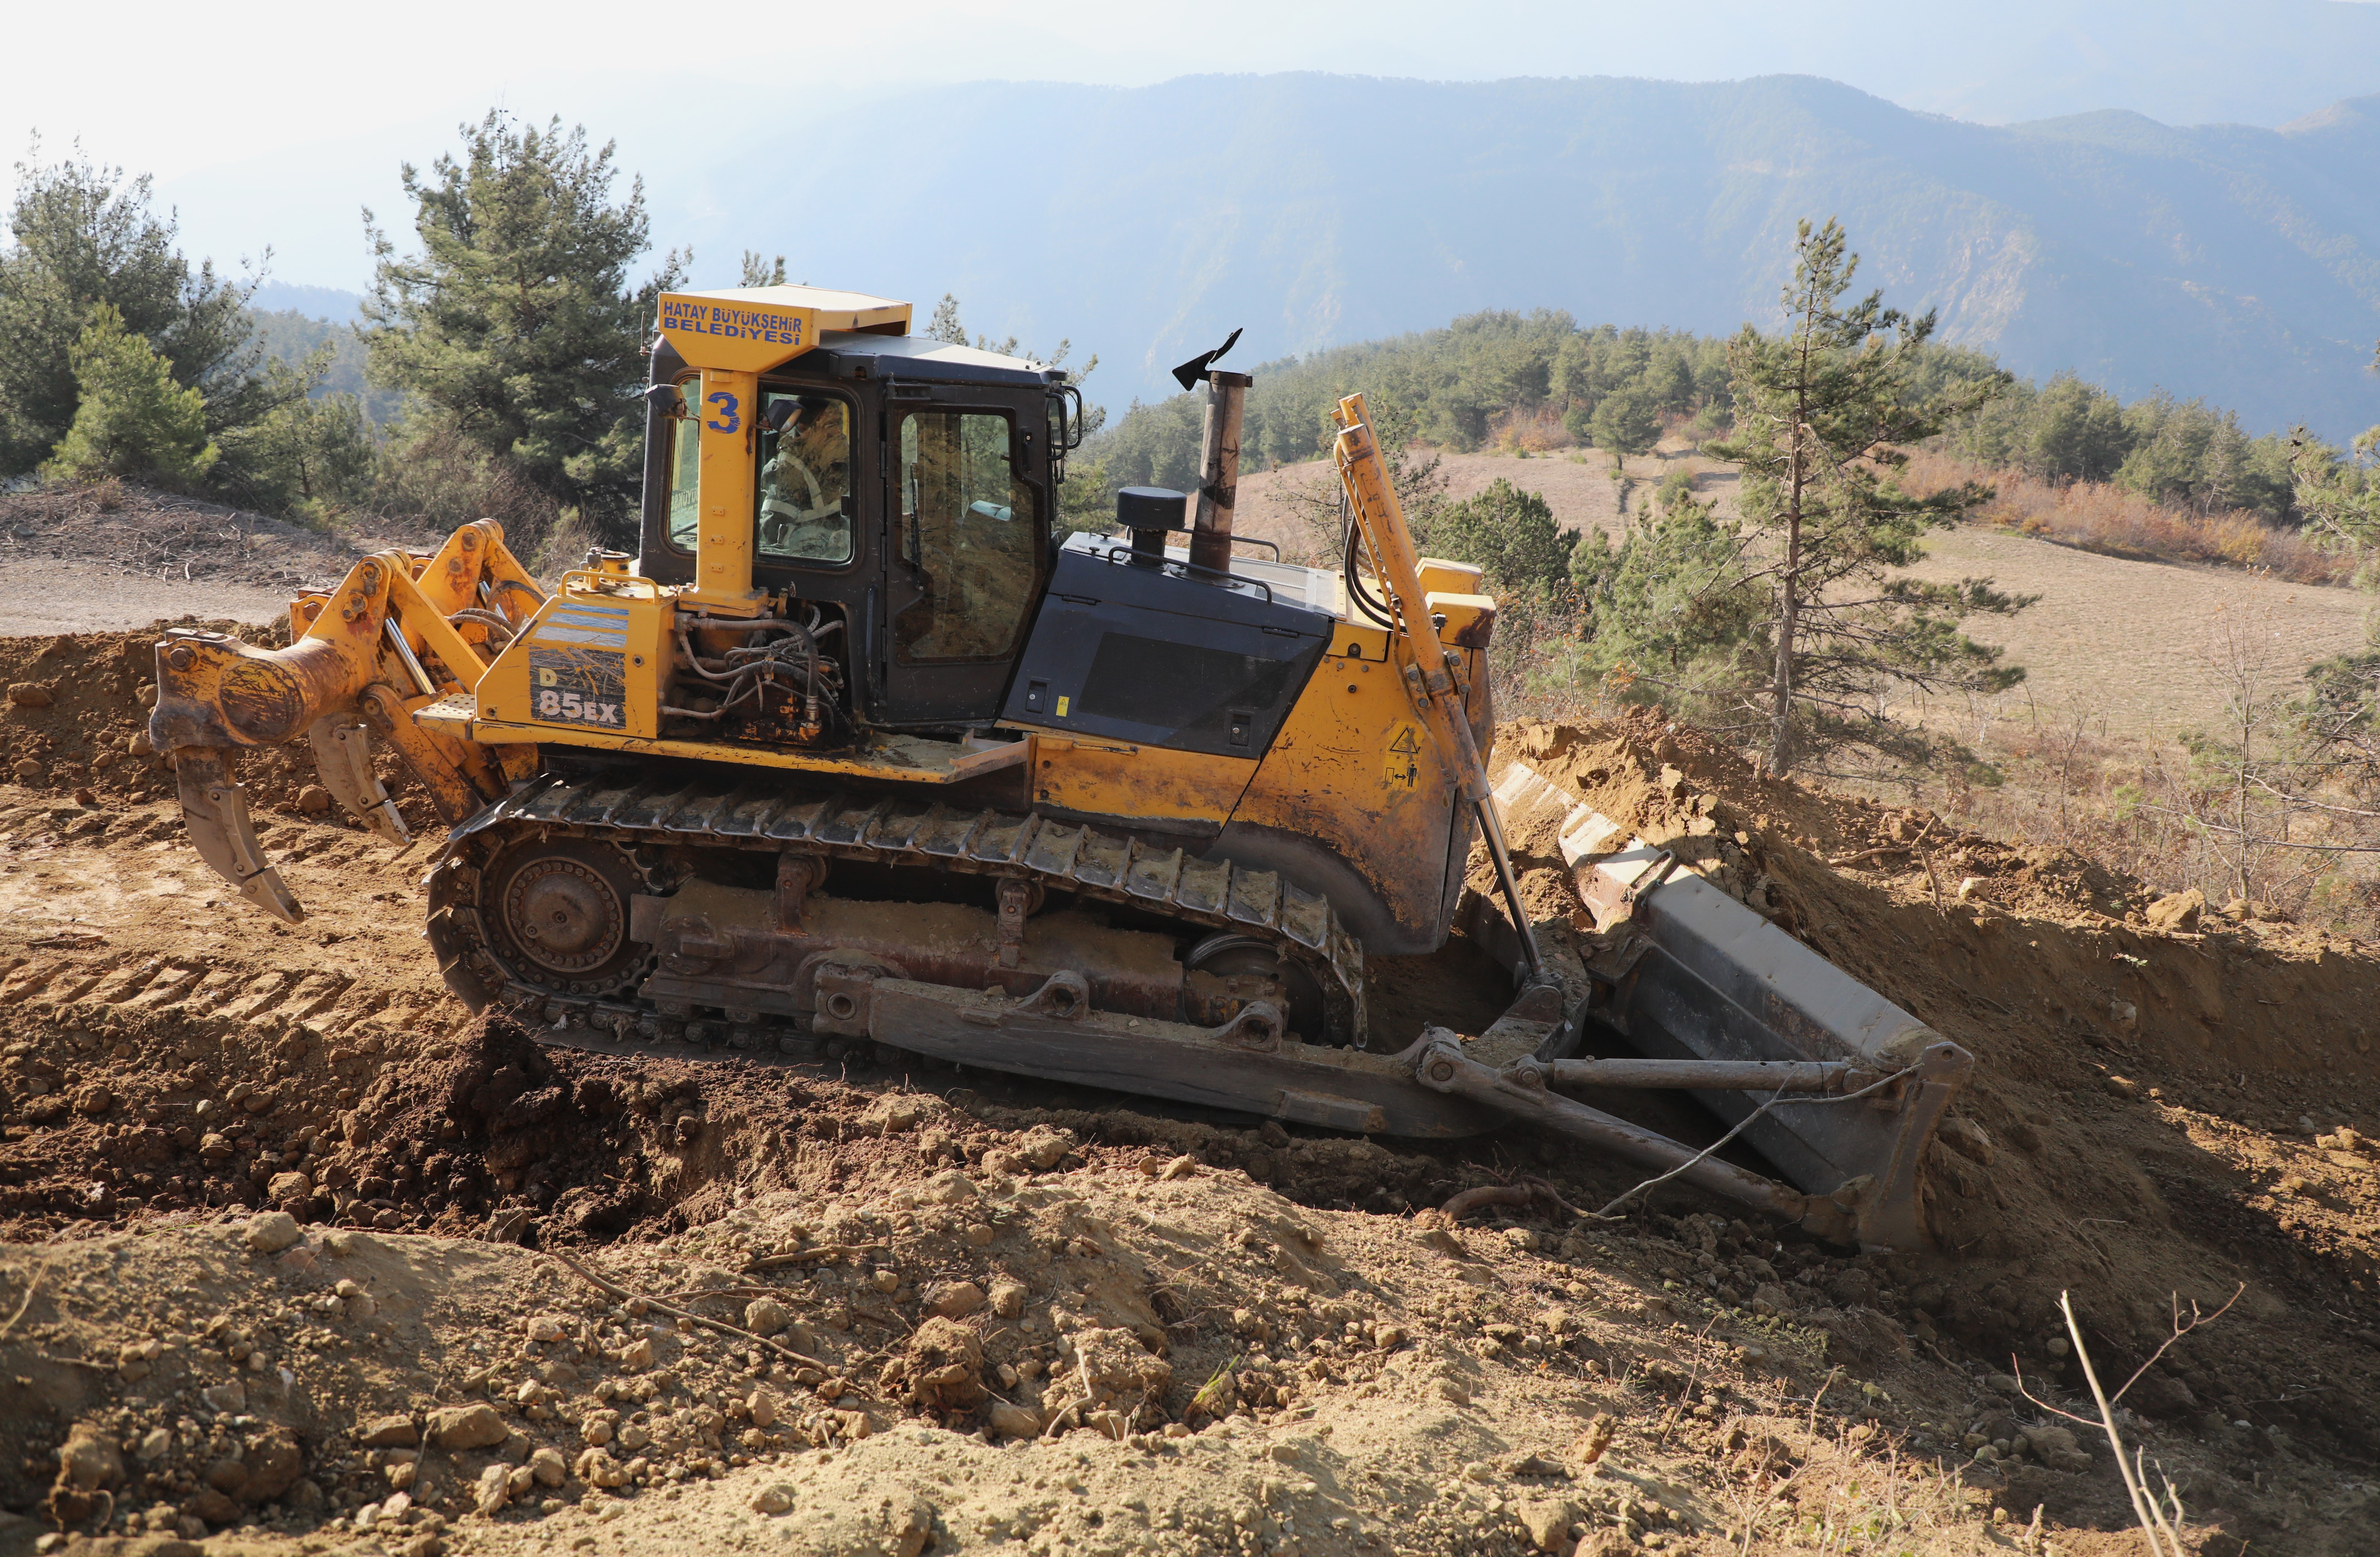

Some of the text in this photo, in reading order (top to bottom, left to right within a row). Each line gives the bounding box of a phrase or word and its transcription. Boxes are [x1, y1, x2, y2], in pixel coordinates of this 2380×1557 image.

[664, 301, 708, 320] HATAY
[707, 392, 740, 434] 3
[540, 667, 557, 687] D
